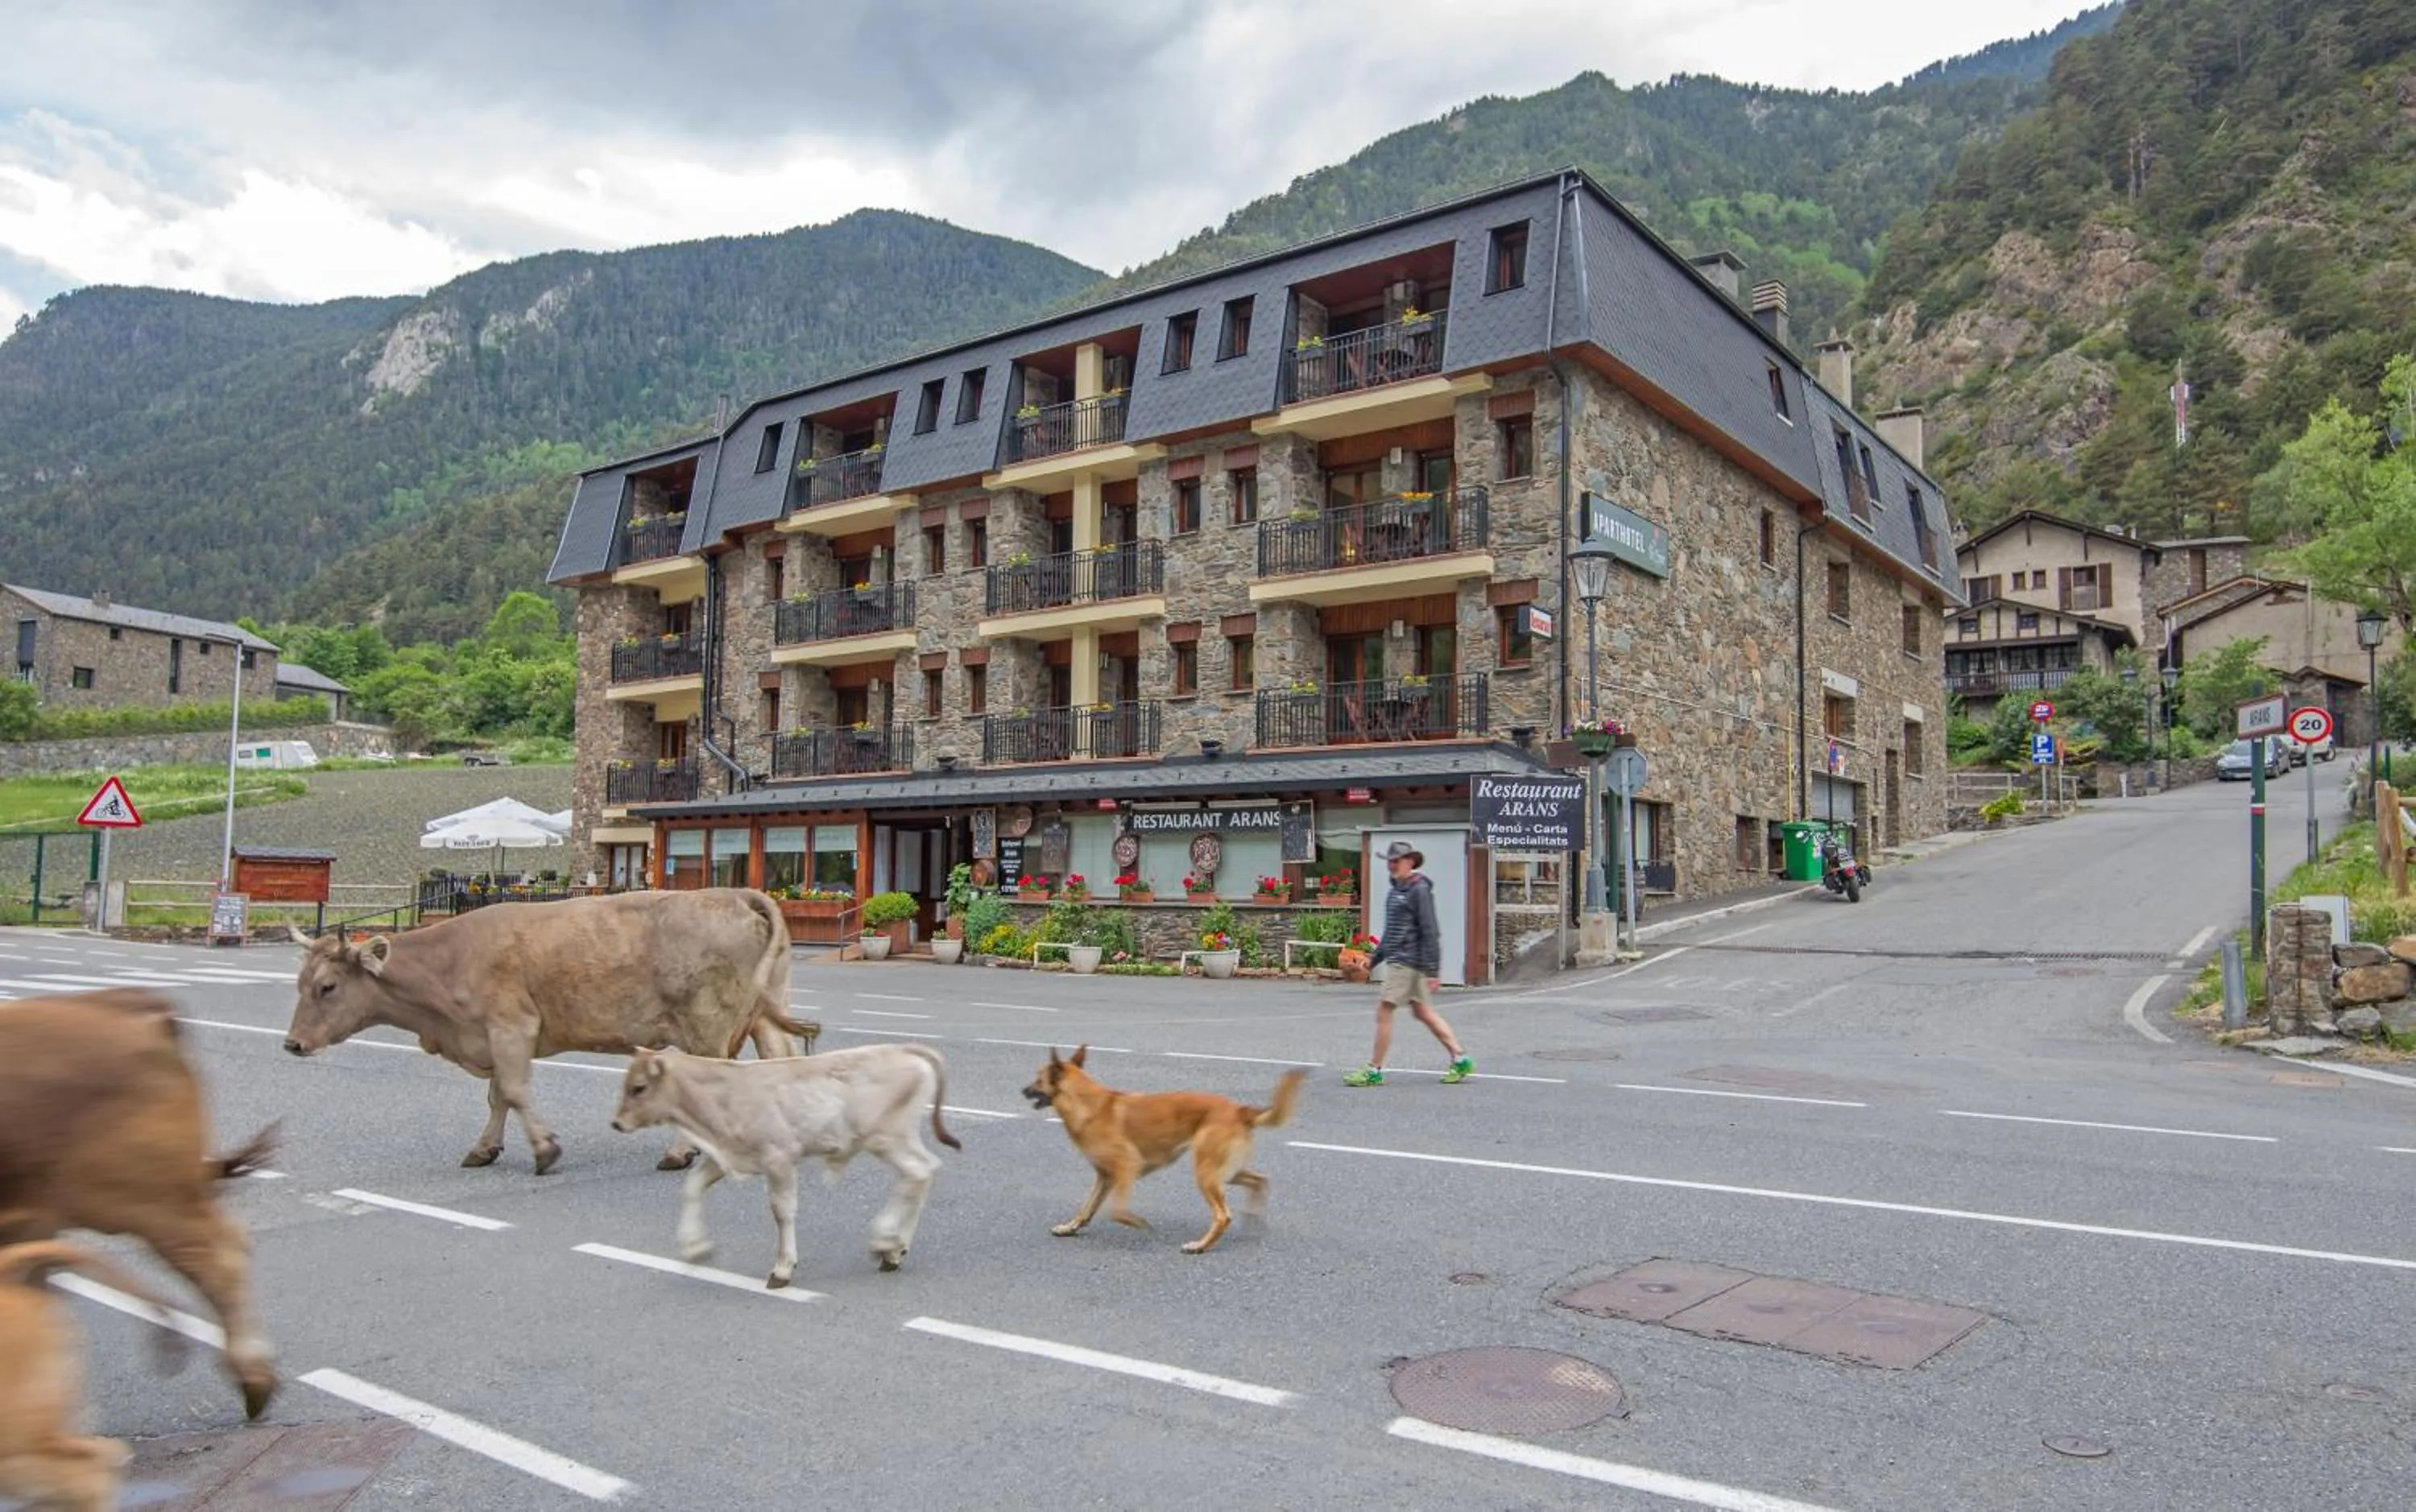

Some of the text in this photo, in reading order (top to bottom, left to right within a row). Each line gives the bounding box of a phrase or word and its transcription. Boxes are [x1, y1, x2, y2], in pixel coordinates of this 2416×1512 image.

[1594, 511, 1645, 553] APARTHOTEL
[2300, 719, 2322, 730] 20
[2037, 735, 2049, 748] P
[1477, 779, 1582, 799] Restaurant
[1499, 801, 1559, 817] ARANS
[1133, 811, 1281, 828] RESTAURANT ARANS
[1487, 822, 1522, 833] Menú
[1533, 824, 1568, 834] Carta
[1487, 835, 1568, 845] Especialitats
